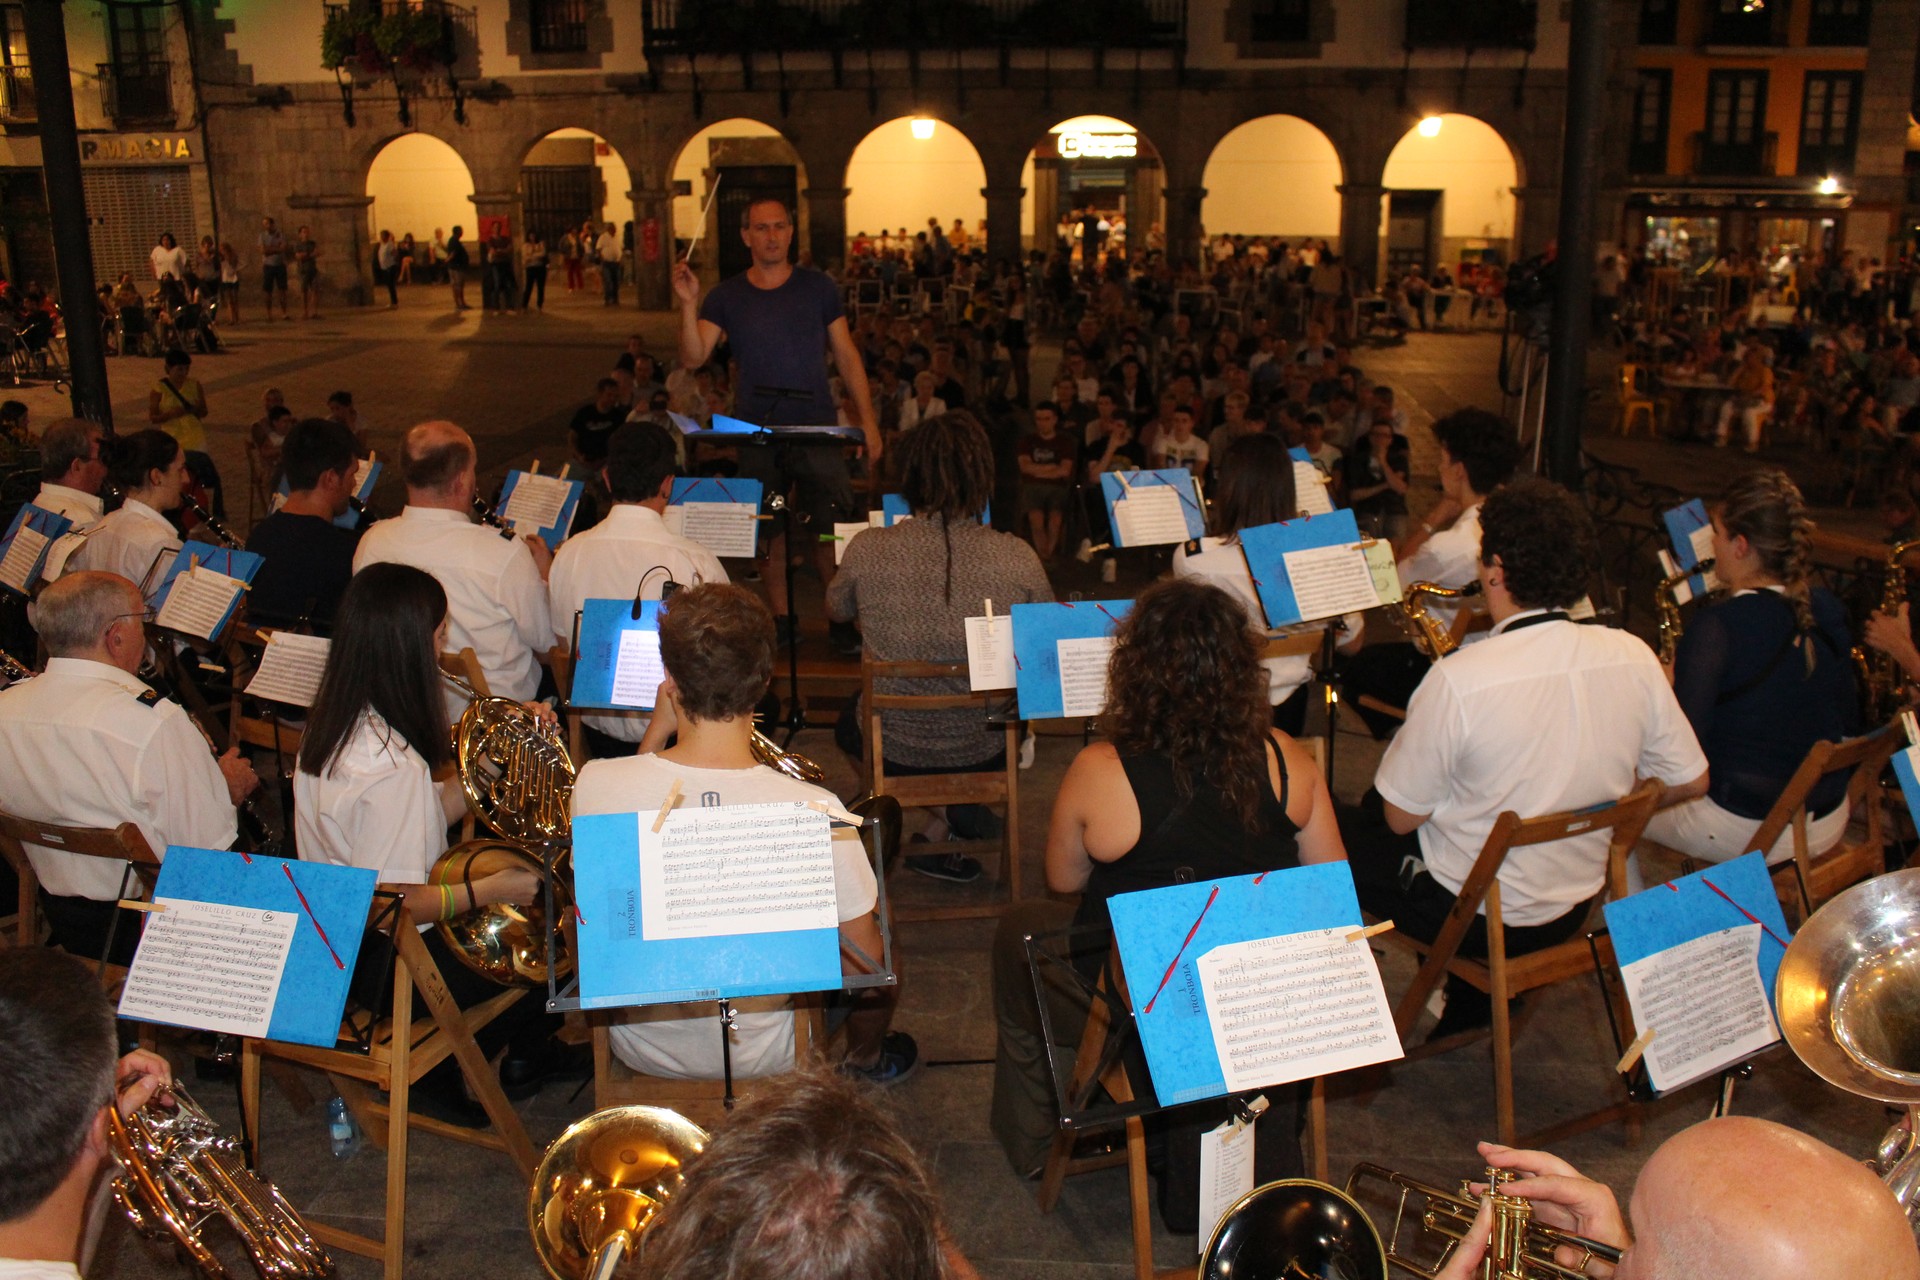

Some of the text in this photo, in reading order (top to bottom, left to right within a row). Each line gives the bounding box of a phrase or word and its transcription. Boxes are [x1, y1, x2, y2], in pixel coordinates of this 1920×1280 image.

[81, 137, 193, 161] RMACIA
[191, 904, 232, 915] JOSELILLO
[235, 910, 257, 920] CRUZ
[627, 890, 636, 937] TRONBOIA
[1247, 935, 1293, 951] JOSELILLO
[1297, 931, 1320, 941] CRUZ
[1182, 963, 1201, 1015] TRONBOIA
